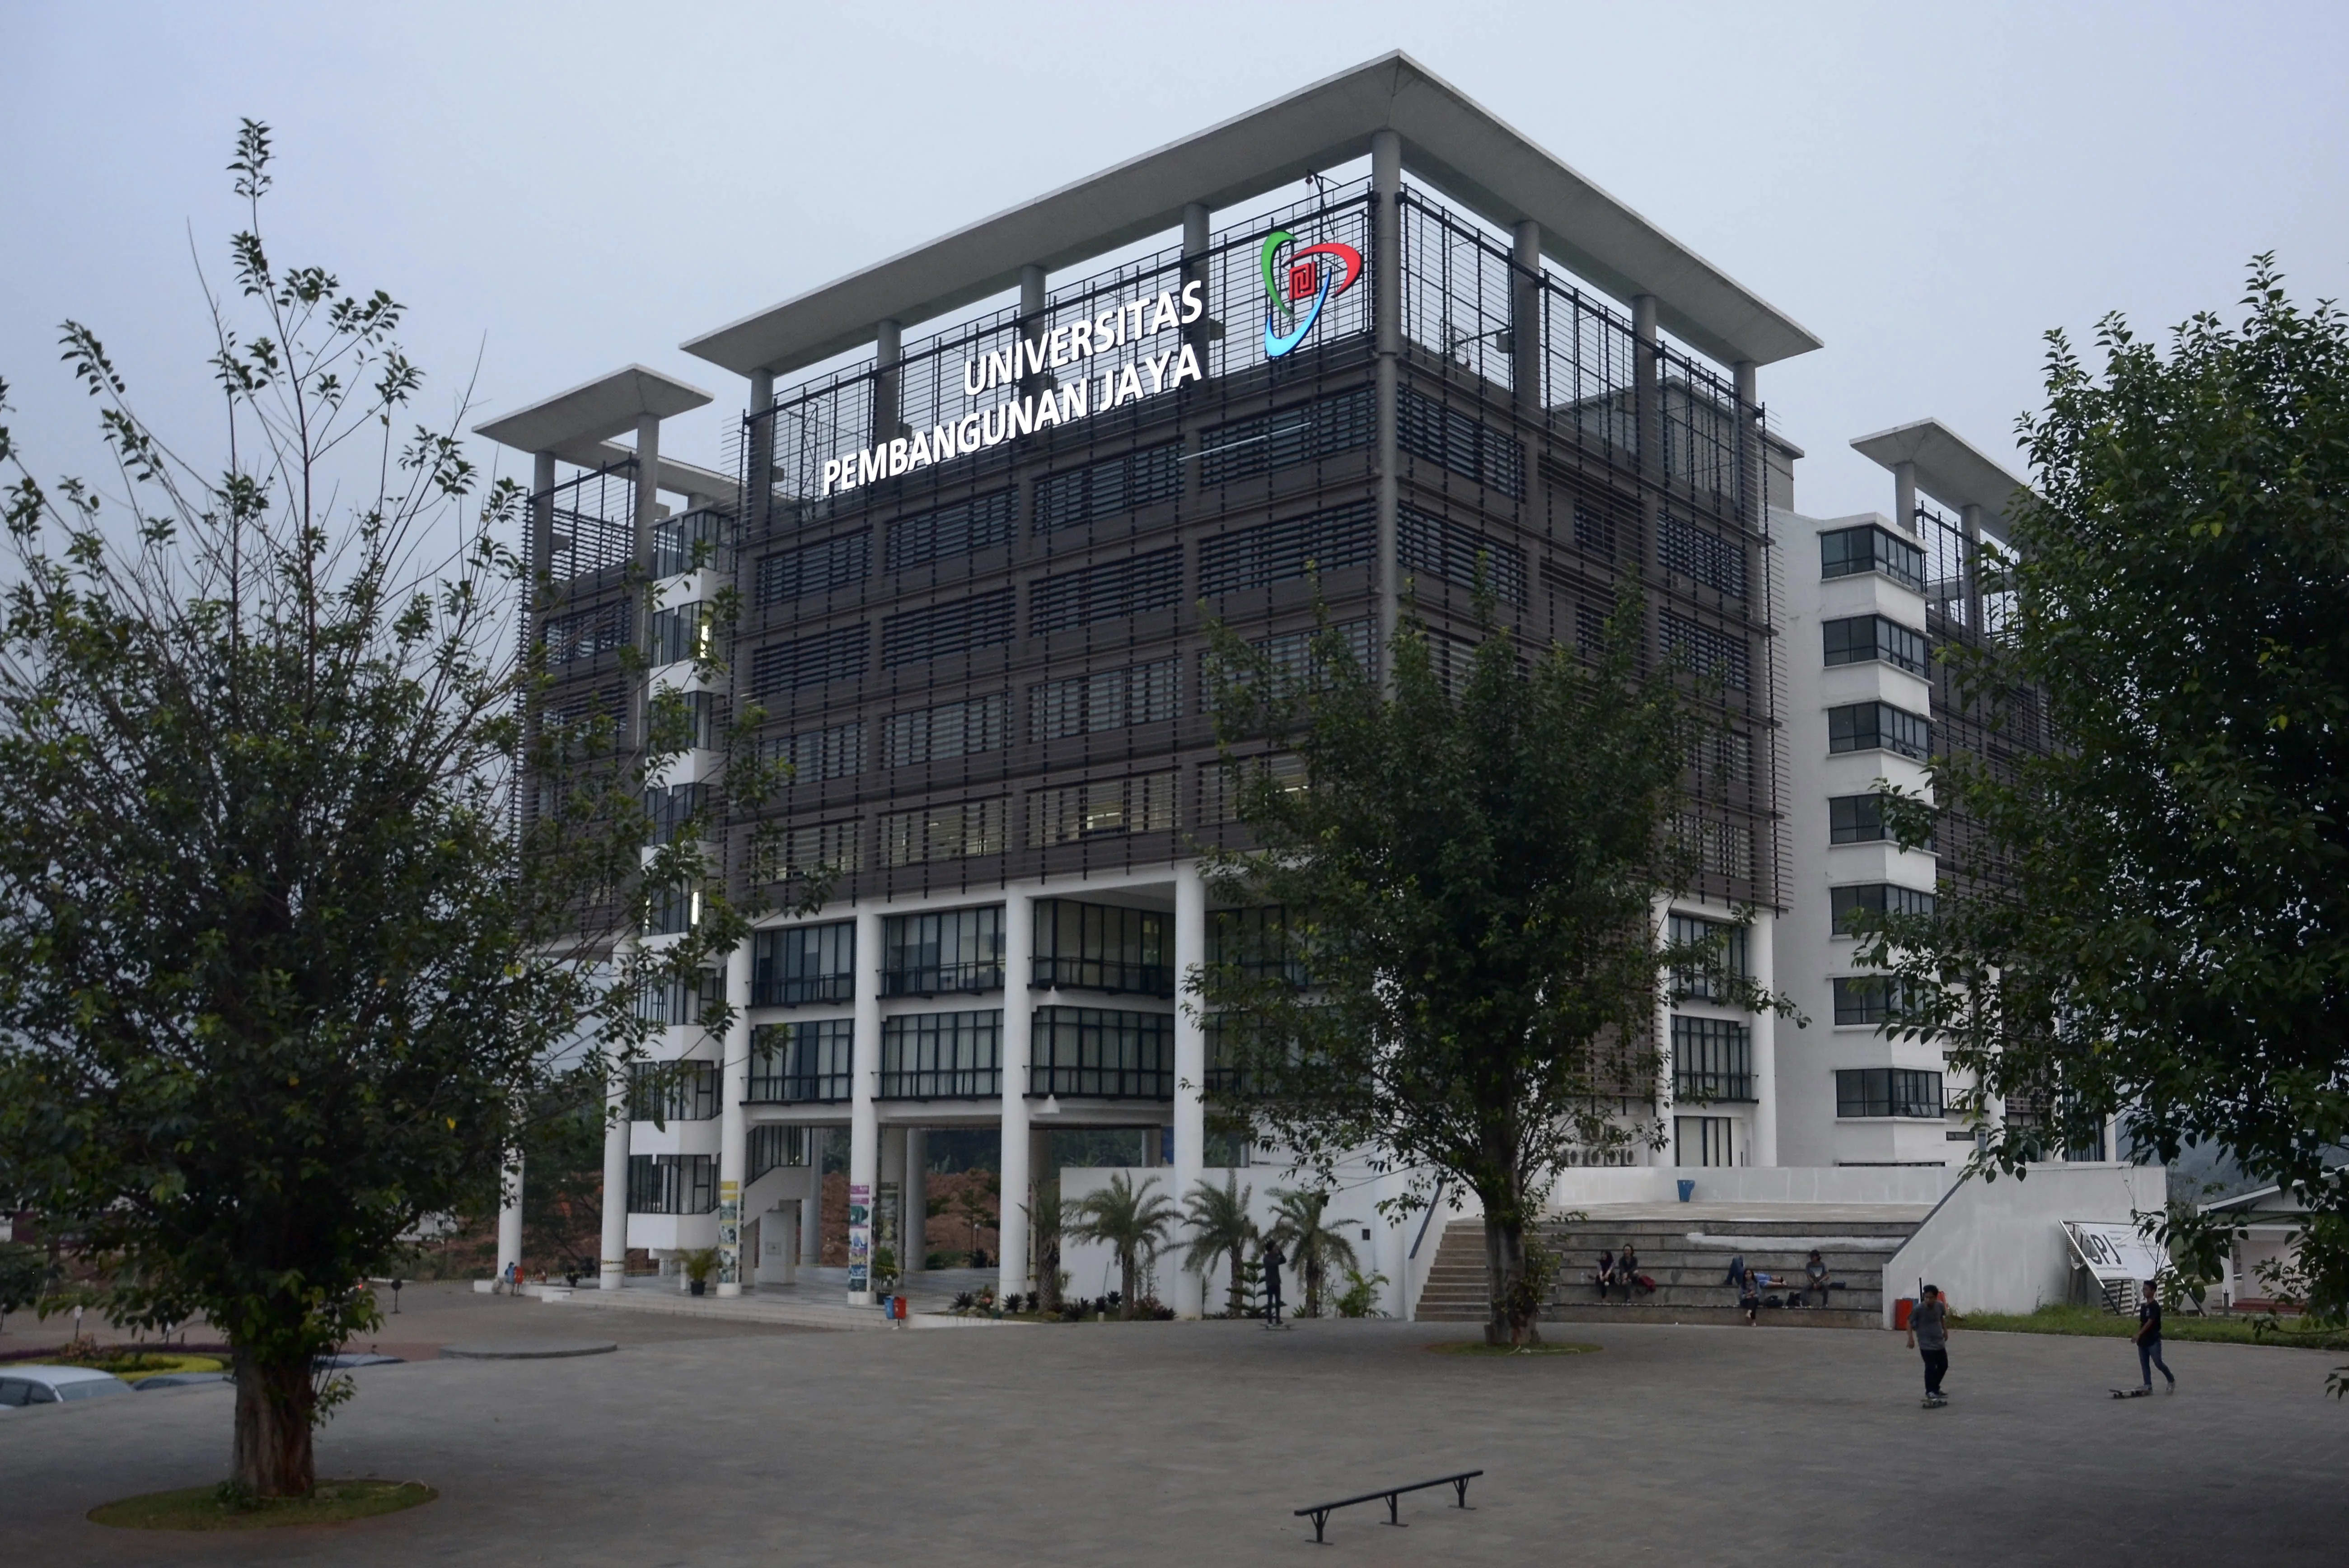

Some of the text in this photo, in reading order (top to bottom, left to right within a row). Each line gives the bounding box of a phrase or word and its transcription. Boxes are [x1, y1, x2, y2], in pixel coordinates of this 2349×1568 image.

[964, 280, 1203, 396] UNIVERSITAS
[823, 343, 1202, 496] PEMBANGUNAN JAYA
